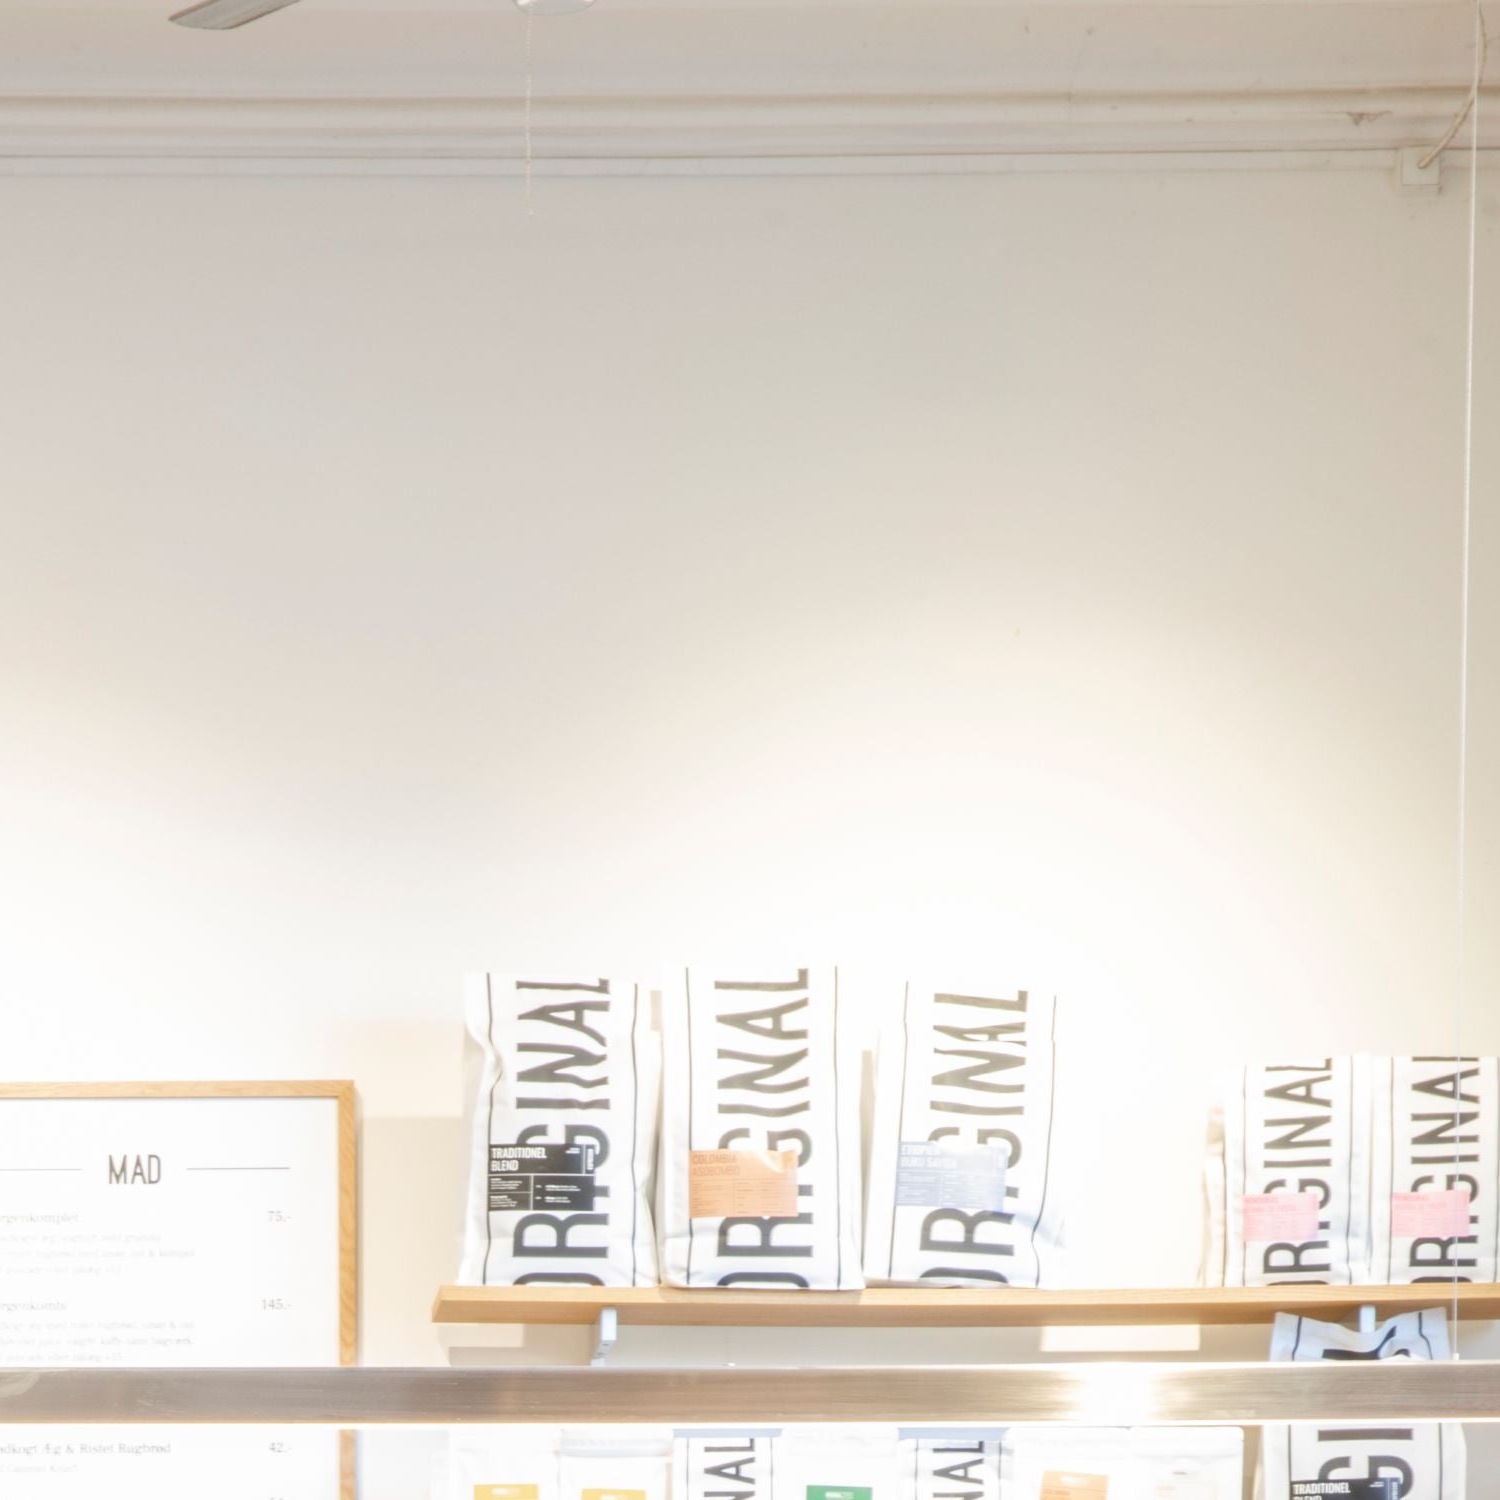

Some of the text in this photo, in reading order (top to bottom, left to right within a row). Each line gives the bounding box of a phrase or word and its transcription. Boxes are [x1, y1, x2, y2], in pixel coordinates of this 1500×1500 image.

[490, 1147, 548, 1159] TRADITIONEL
[108, 1154, 162, 1185] MAD
[490, 1160, 519, 1172] BLEND
[1292, 1482, 1351, 1495] TRADITIONEL
